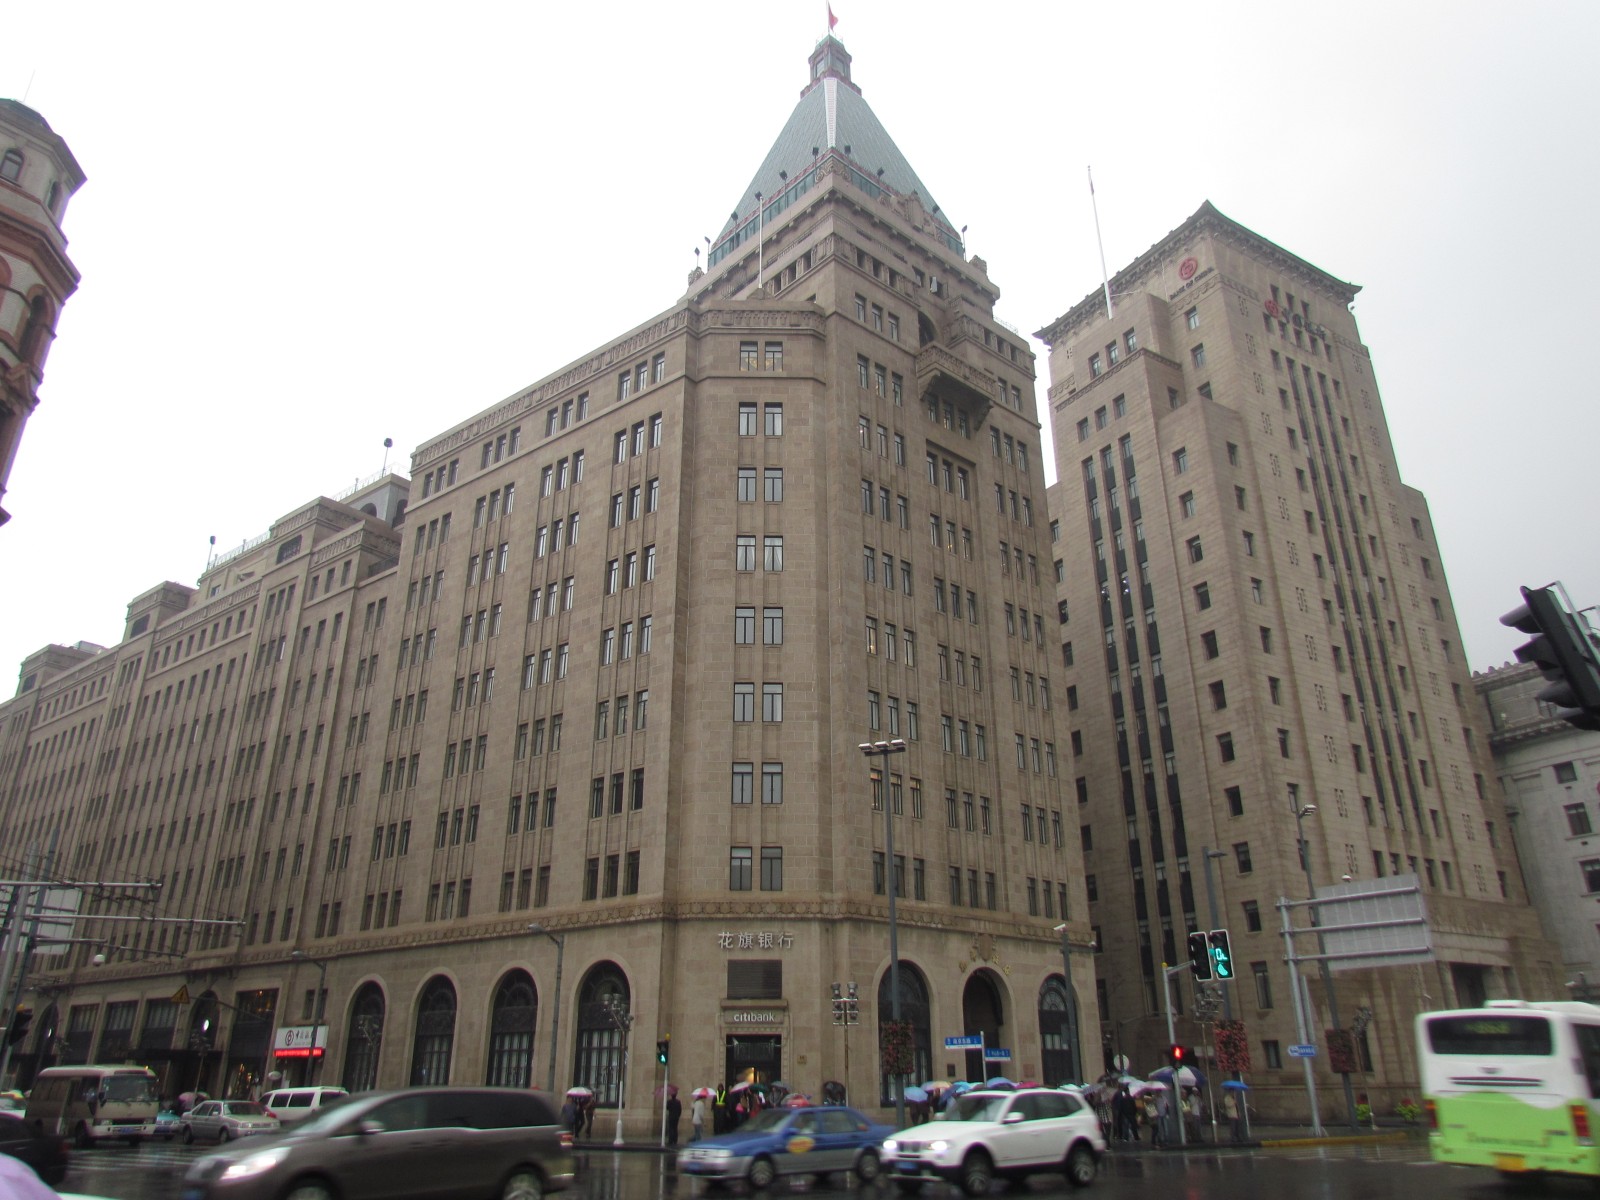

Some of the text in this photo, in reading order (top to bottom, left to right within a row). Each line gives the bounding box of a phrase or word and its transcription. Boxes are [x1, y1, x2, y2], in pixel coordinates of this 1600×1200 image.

[717, 931, 794, 949] 花旗银行
[733, 1012, 775, 1022] citibank
